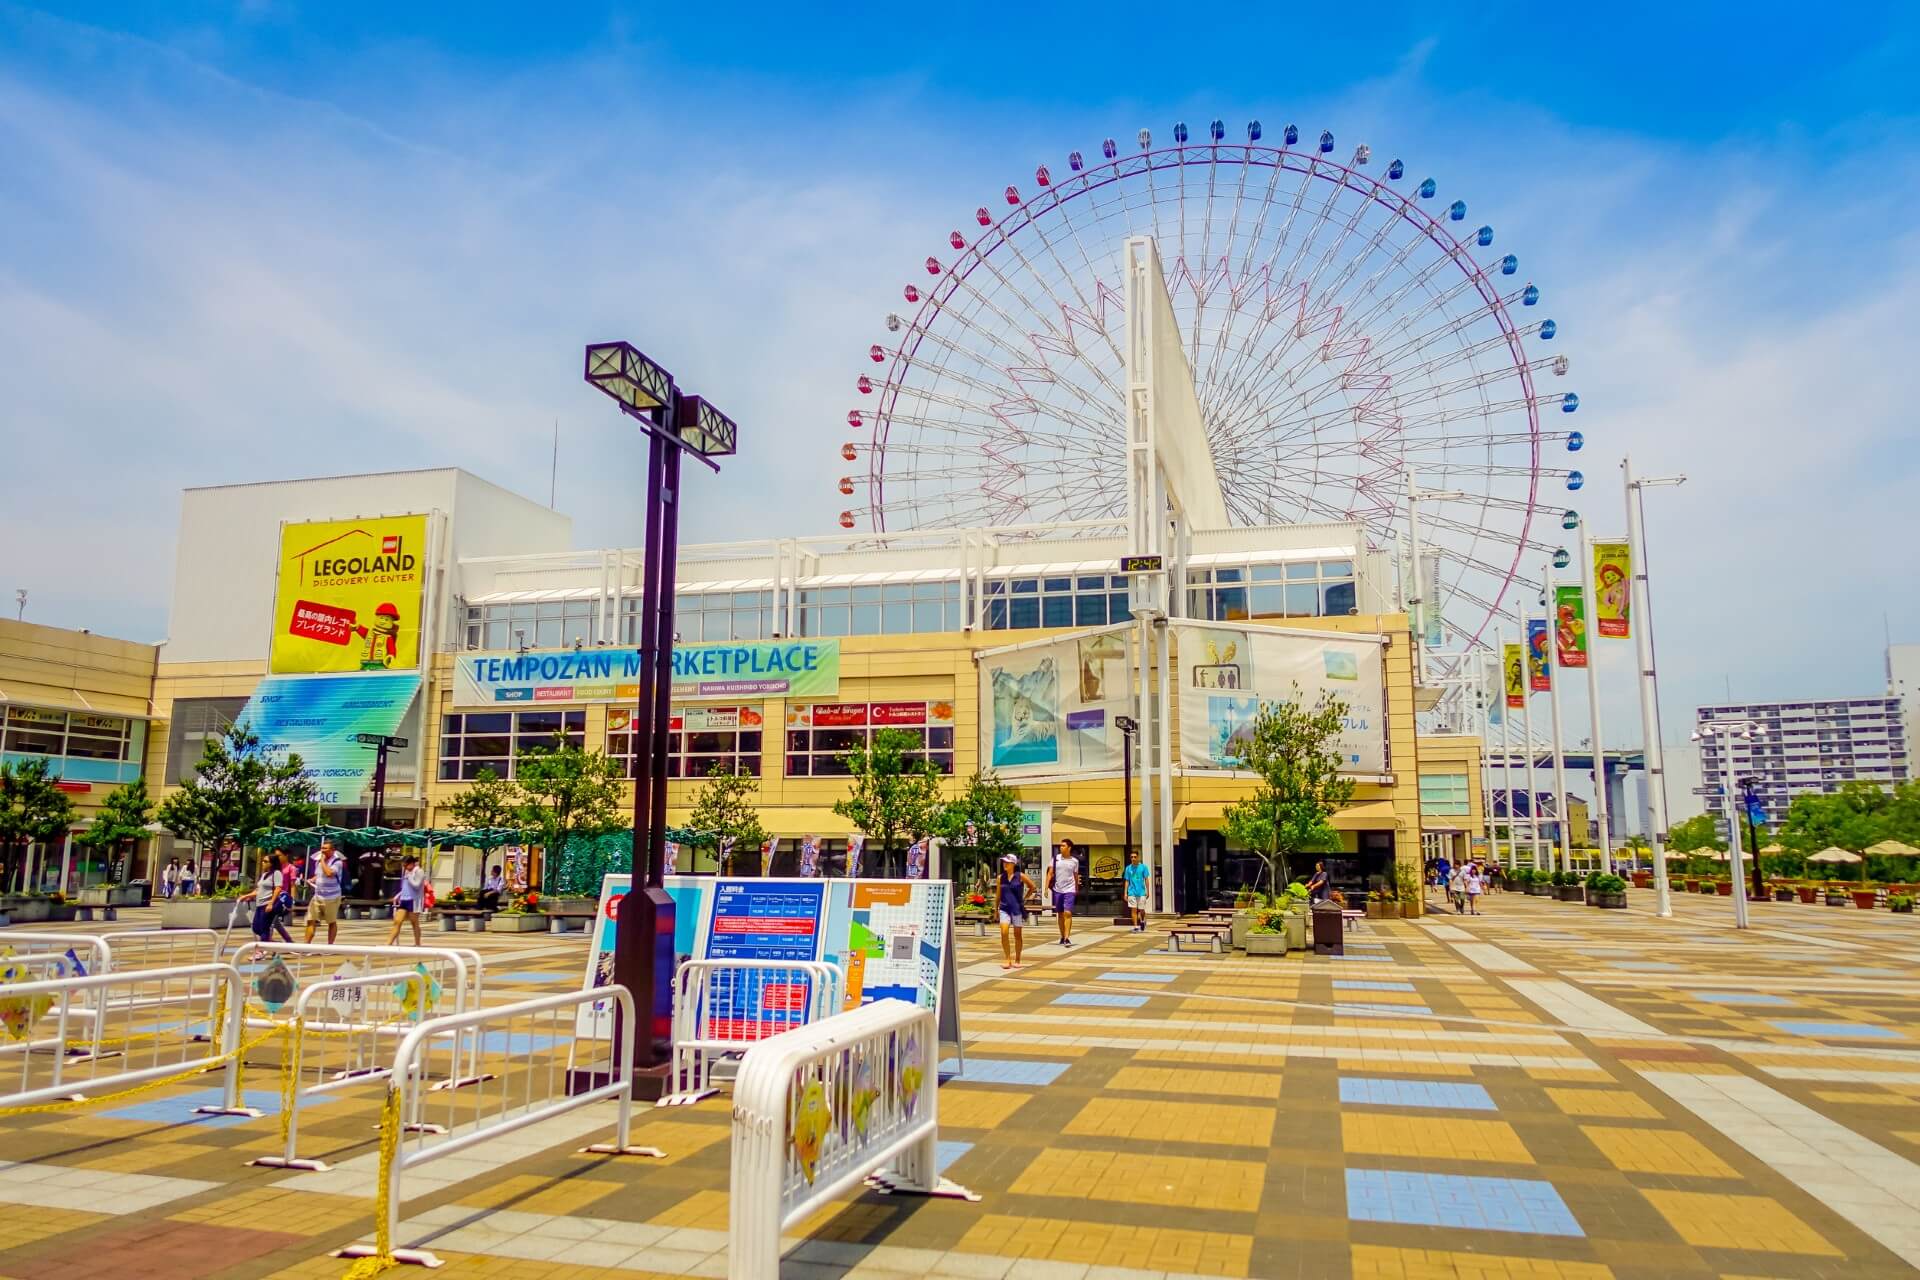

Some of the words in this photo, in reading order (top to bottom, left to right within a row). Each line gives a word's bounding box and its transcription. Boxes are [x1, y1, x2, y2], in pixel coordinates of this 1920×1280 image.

[314, 544, 415, 577] LEGOLAND
[313, 576, 369, 587] DISCOVERY
[373, 573, 415, 583] CENTER
[473, 655, 611, 682] TEMPOZAN
[623, 646, 818, 678] MRKETPLACE
[505, 690, 523, 698] SHOP
[536, 689, 572, 697] RESTAURANT
